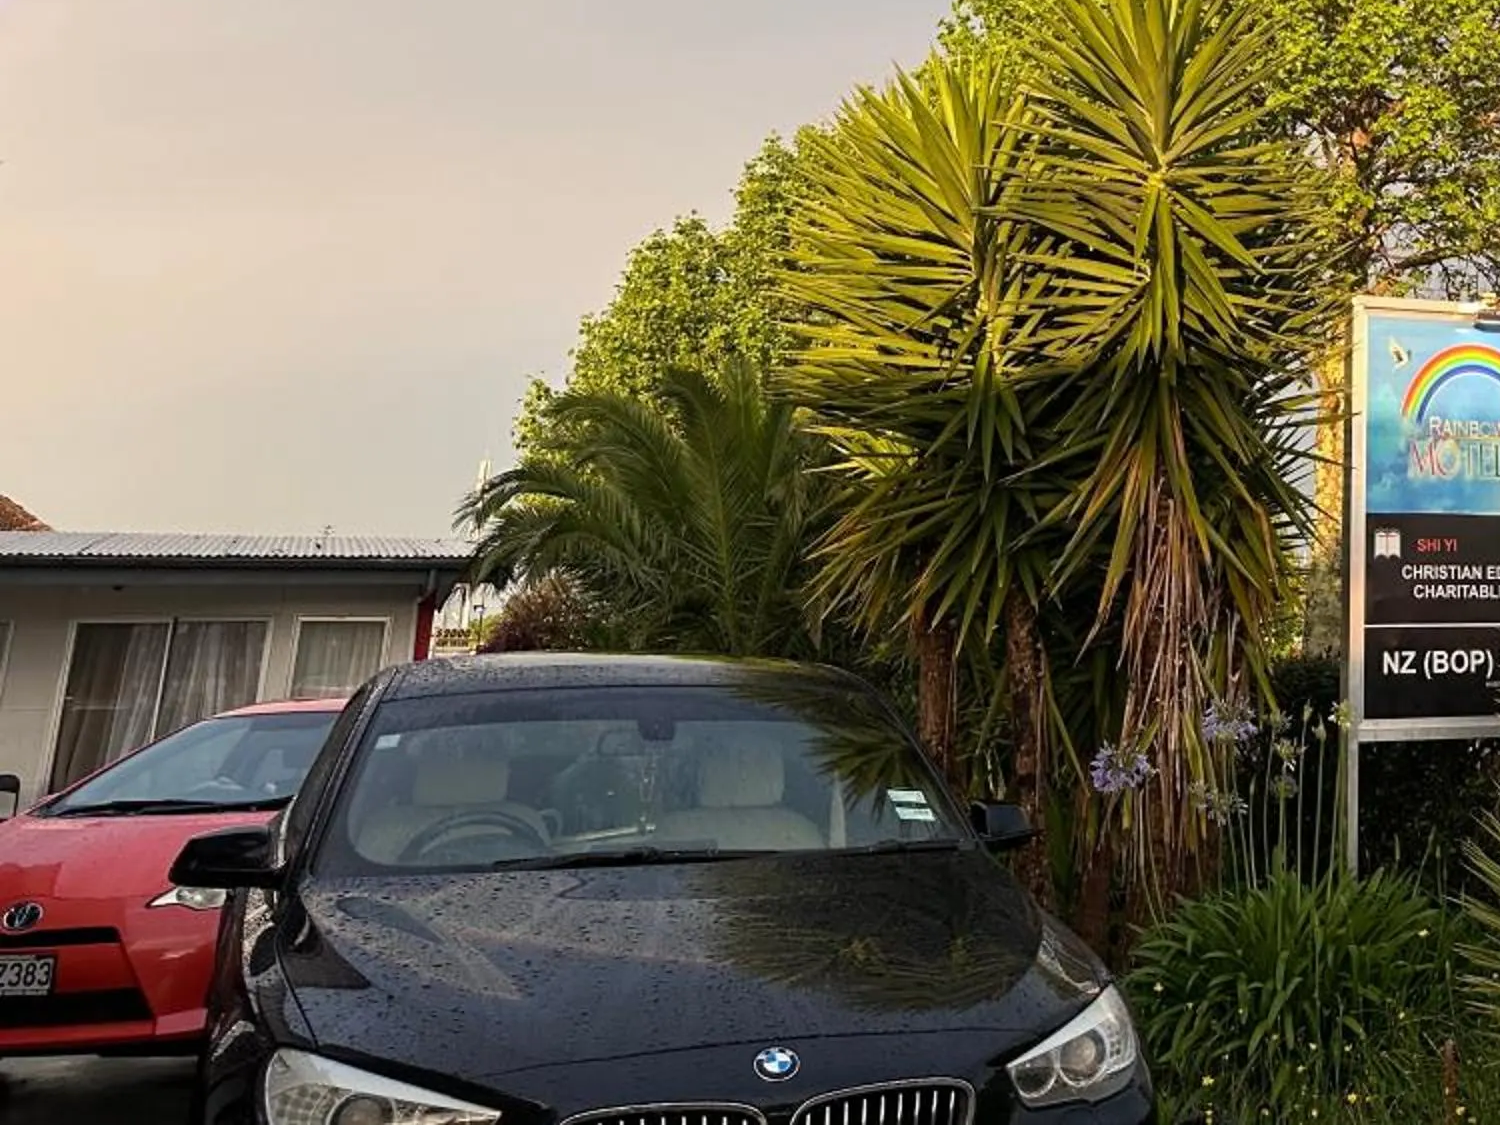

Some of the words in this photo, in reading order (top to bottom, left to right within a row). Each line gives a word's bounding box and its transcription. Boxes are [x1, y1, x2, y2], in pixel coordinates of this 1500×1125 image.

[1416, 539, 1441, 552] SHI
[1444, 539, 1458, 552] YI
[1401, 565, 1483, 580] CHRISTIAN
[1382, 650, 1417, 675] NZ
[1423, 650, 1494, 679] (BOP)
